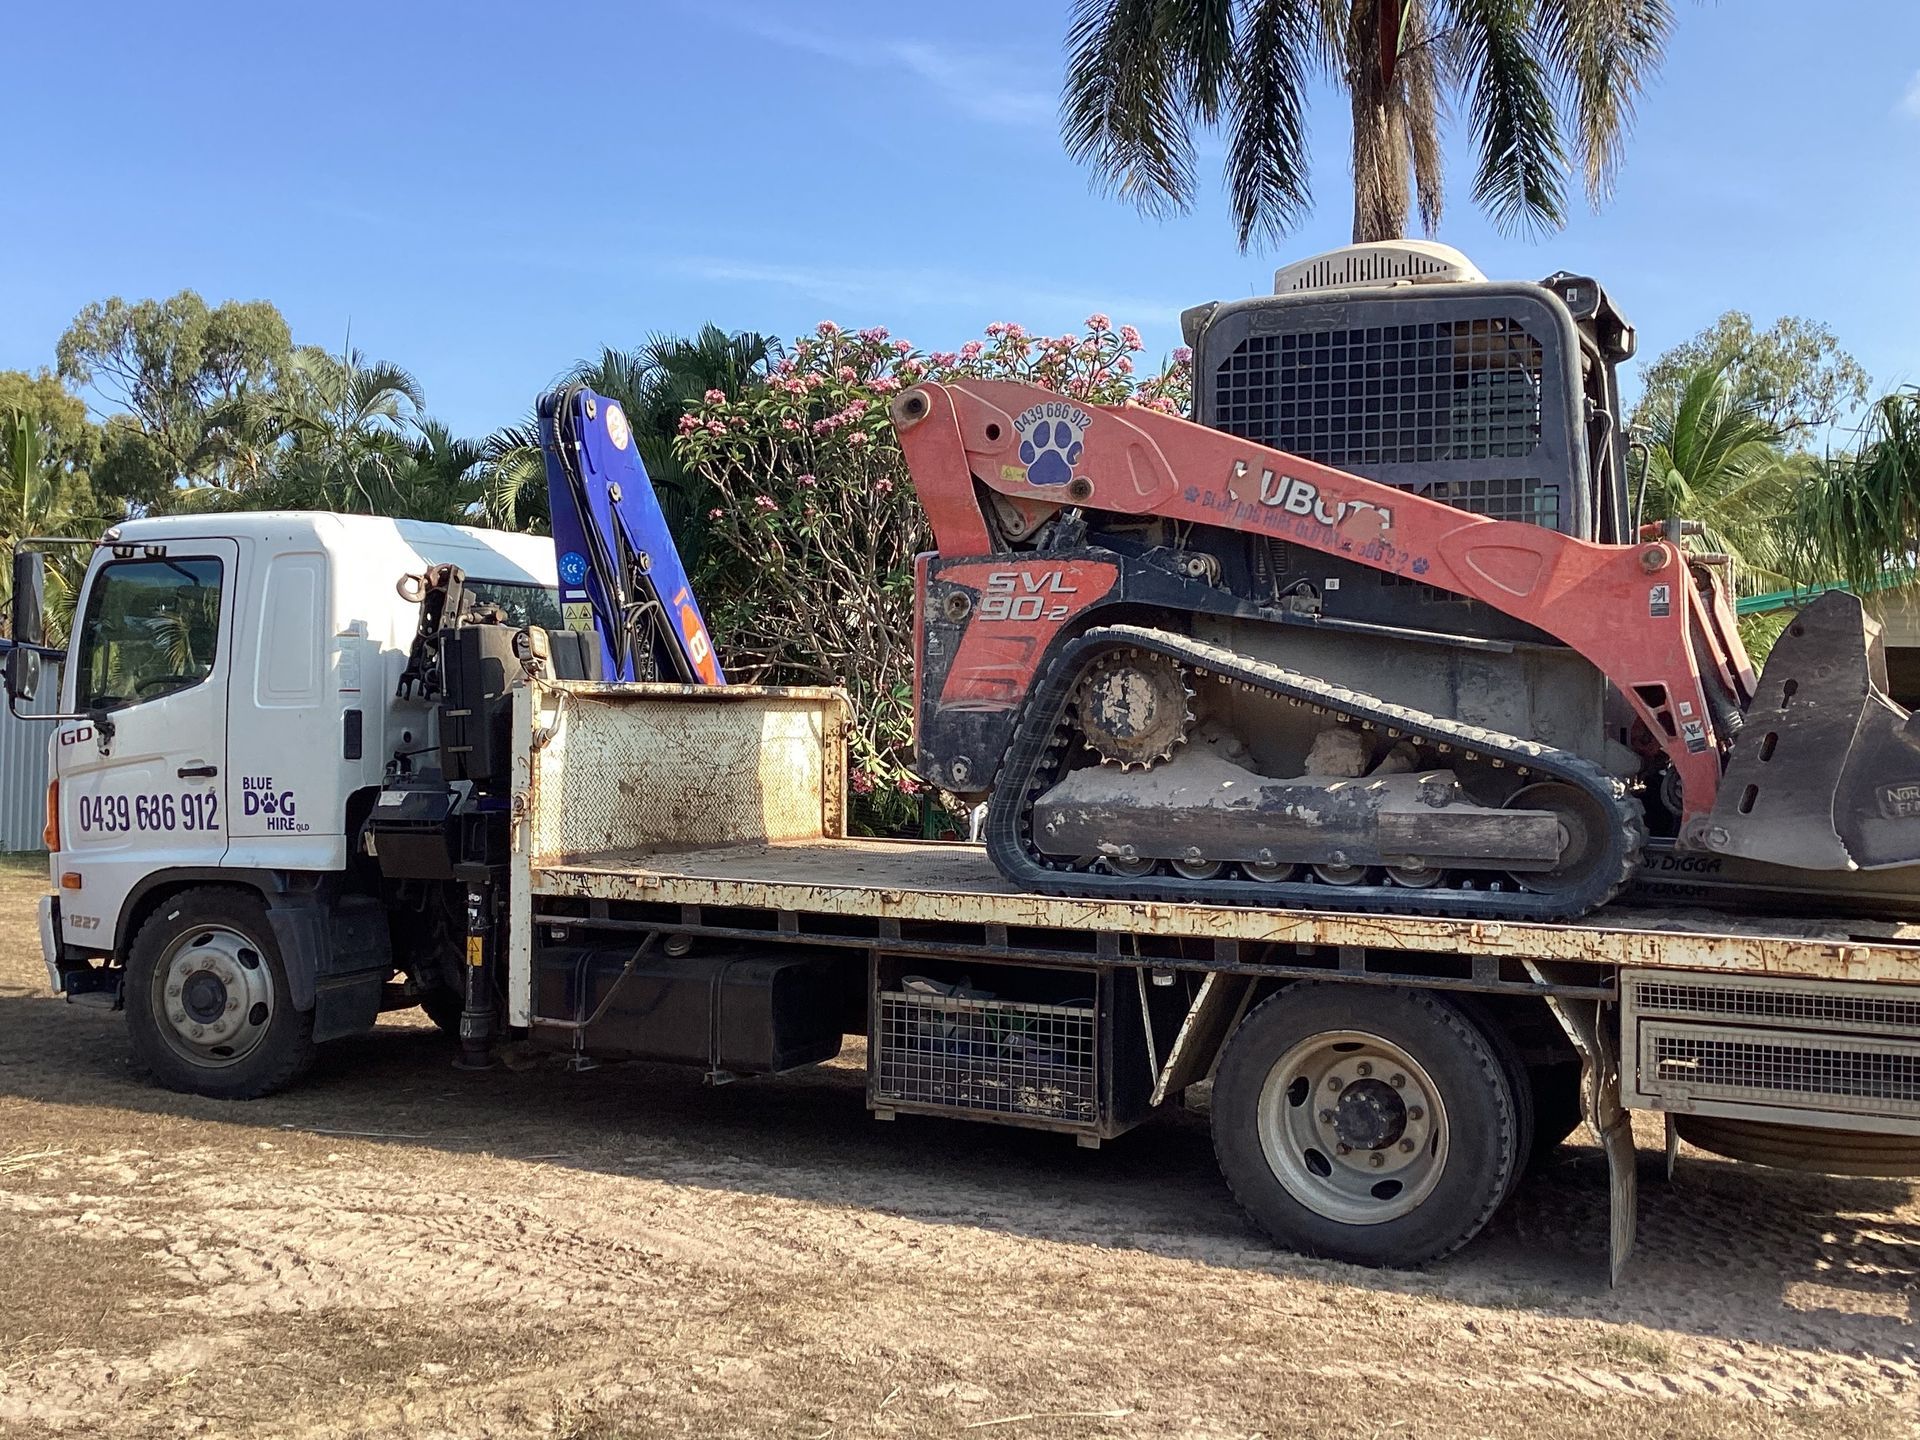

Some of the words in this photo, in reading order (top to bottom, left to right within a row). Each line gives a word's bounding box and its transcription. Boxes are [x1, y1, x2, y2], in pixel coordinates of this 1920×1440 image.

[1013, 405, 1044, 433] 0439
[1046, 403, 1071, 420] 686
[1070, 409, 1092, 432] 912
[567, 563, 578, 574] CE
[986, 571, 1078, 593] SVL
[979, 596, 1070, 621] 90-2
[61, 726, 93, 746] GD
[242, 776, 273, 790] BLUE
[80, 795, 130, 832] 0439
[136, 794, 176, 831] 686
[181, 793, 220, 831] 912
[267, 817, 295, 831] HIRE
[296, 823, 310, 833] QLD
[70, 914, 100, 930] 1227
